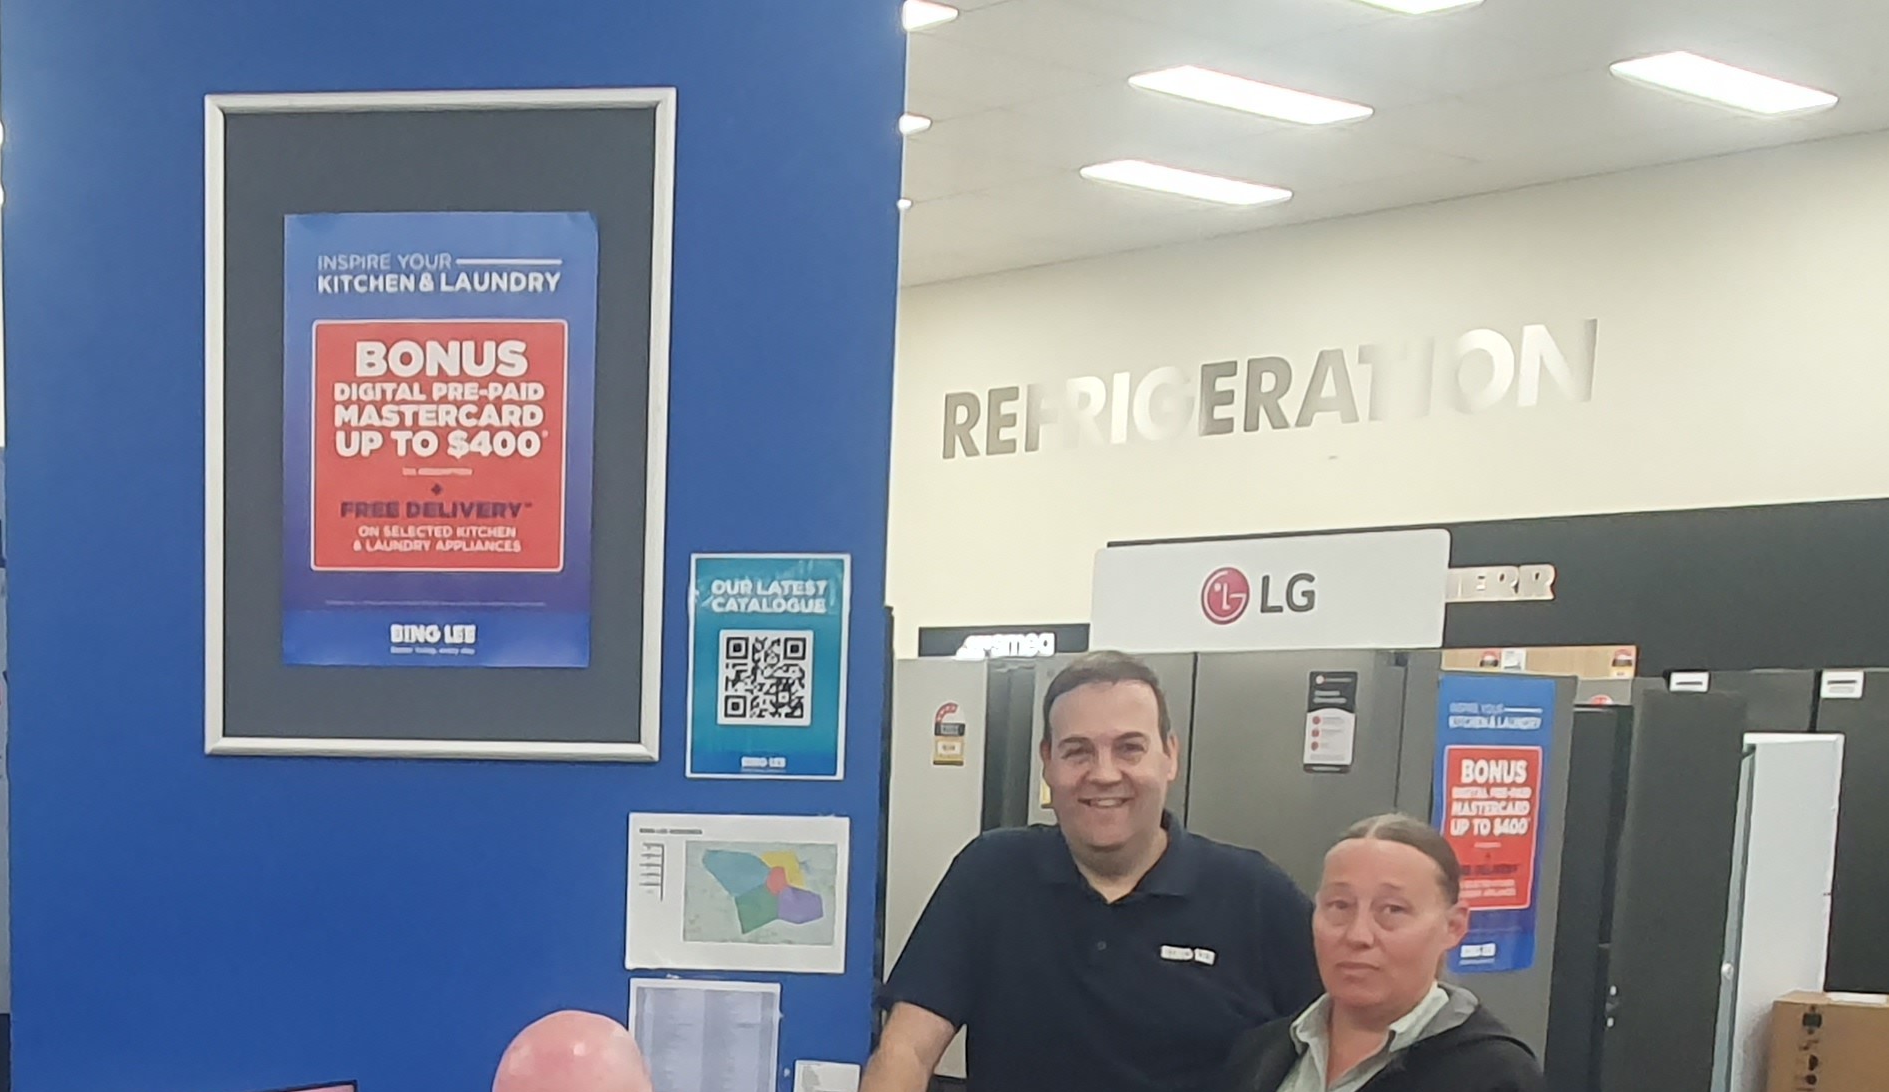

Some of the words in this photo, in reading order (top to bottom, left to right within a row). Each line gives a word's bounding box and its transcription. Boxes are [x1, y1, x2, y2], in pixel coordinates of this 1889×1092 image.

[318, 254, 391, 272] INSPIRE
[398, 252, 452, 271] YOUR
[317, 274, 415, 294] KITCHEN
[418, 271, 435, 292] &
[440, 271, 561, 293] LAUNDRY
[355, 339, 529, 379] BONUS
[333, 382, 427, 402] DIGITAL
[432, 381, 546, 402] PRE-PAID
[942, 318, 1598, 460] REFRIGERATION
[333, 404, 545, 428] MASTERCARD
[334, 431, 384, 458] UP
[390, 431, 439, 458] TO
[340, 501, 400, 519] FREE
[358, 525, 380, 539] ON
[383, 525, 454, 539] SELECTED
[456, 525, 516, 539] KITCHEN
[365, 539, 432, 553] LAUNDRY
[435, 539, 522, 553] APPLIANCES
[711, 580, 753, 596] OUR
[756, 579, 829, 596] LATEST
[1260, 572, 1317, 614] LG
[711, 597, 827, 614] CATALOGUE
[390, 623, 442, 644] BING
[444, 623, 477, 644] LEE
[1461, 759, 1527, 784] BONUS
[1450, 818, 1470, 837] UP
[1473, 818, 1491, 837] TO
